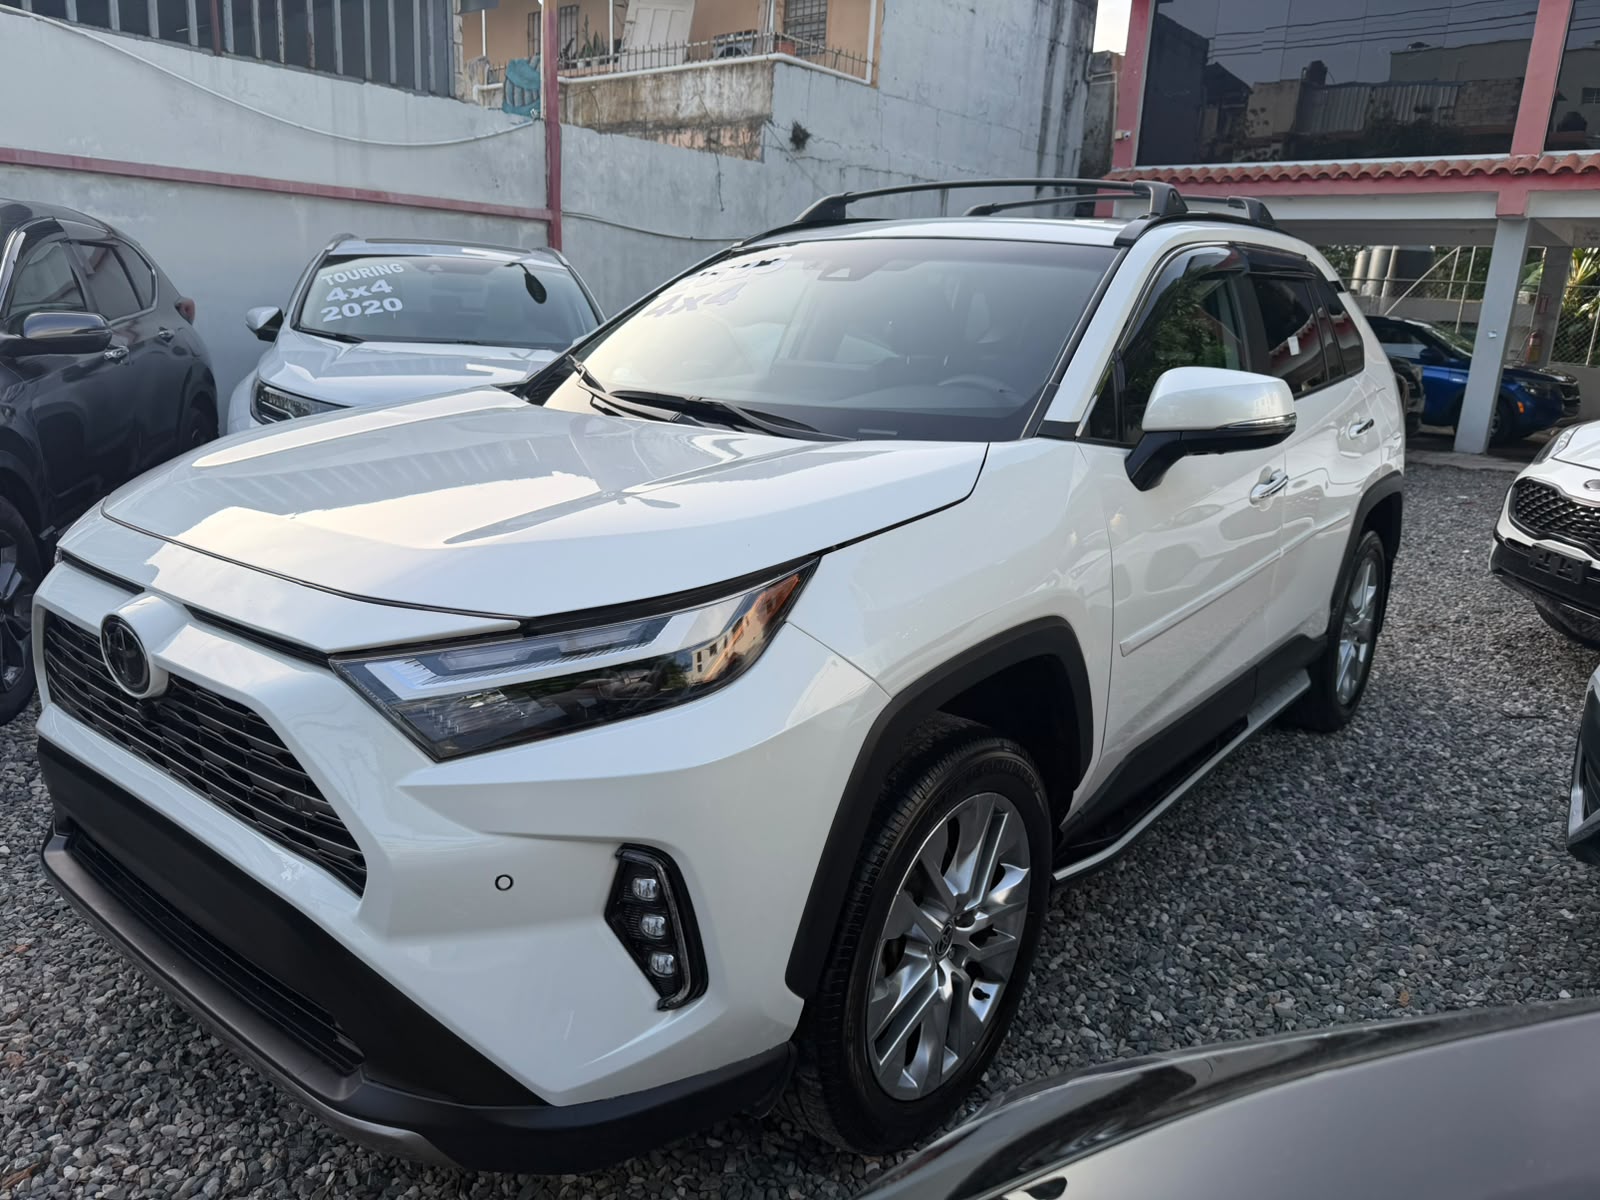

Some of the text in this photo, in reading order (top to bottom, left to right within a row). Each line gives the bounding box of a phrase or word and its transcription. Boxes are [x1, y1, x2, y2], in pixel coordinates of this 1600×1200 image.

[321, 263, 404, 285] TOURING
[326, 279, 393, 301] 4x4
[643, 282, 747, 317] 4x4
[320, 298, 403, 322] 2020
